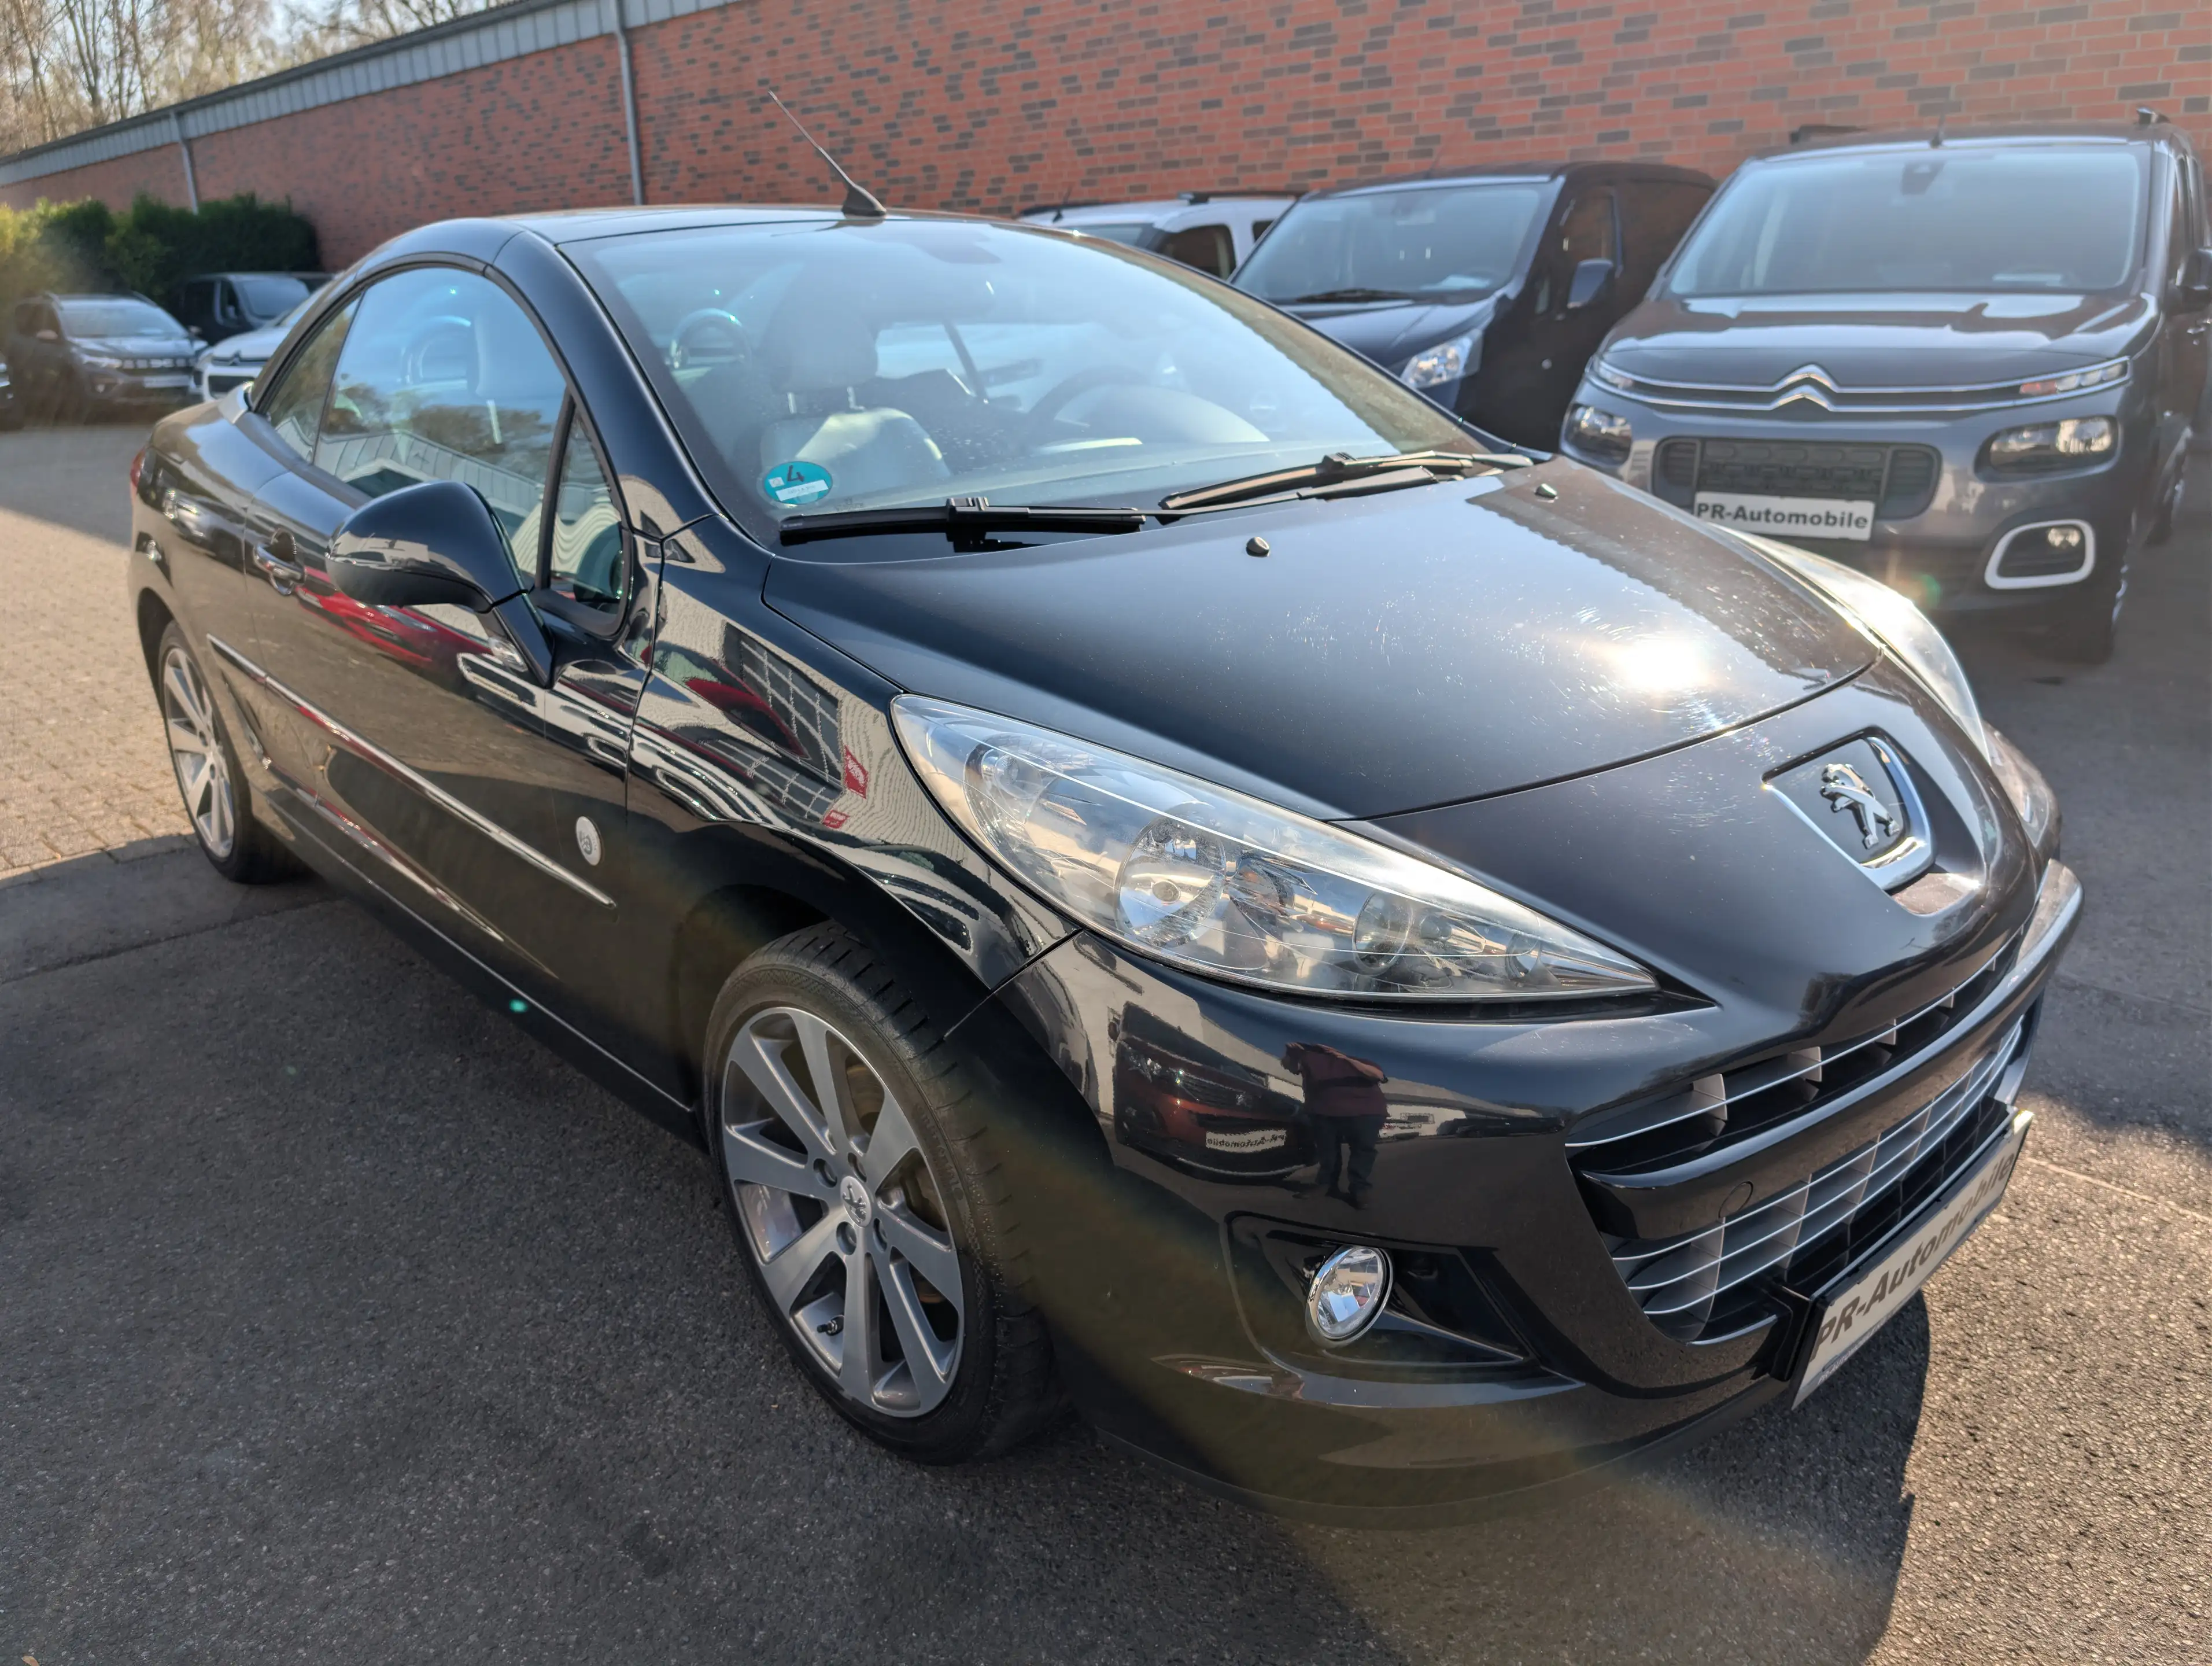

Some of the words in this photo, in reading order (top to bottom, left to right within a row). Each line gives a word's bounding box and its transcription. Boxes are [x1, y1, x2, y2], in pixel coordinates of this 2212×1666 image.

[787, 465, 804, 482] 4
[1697, 502, 1868, 529] PR-Automobile
[1810, 1152, 2014, 1362] PR-Automobile
